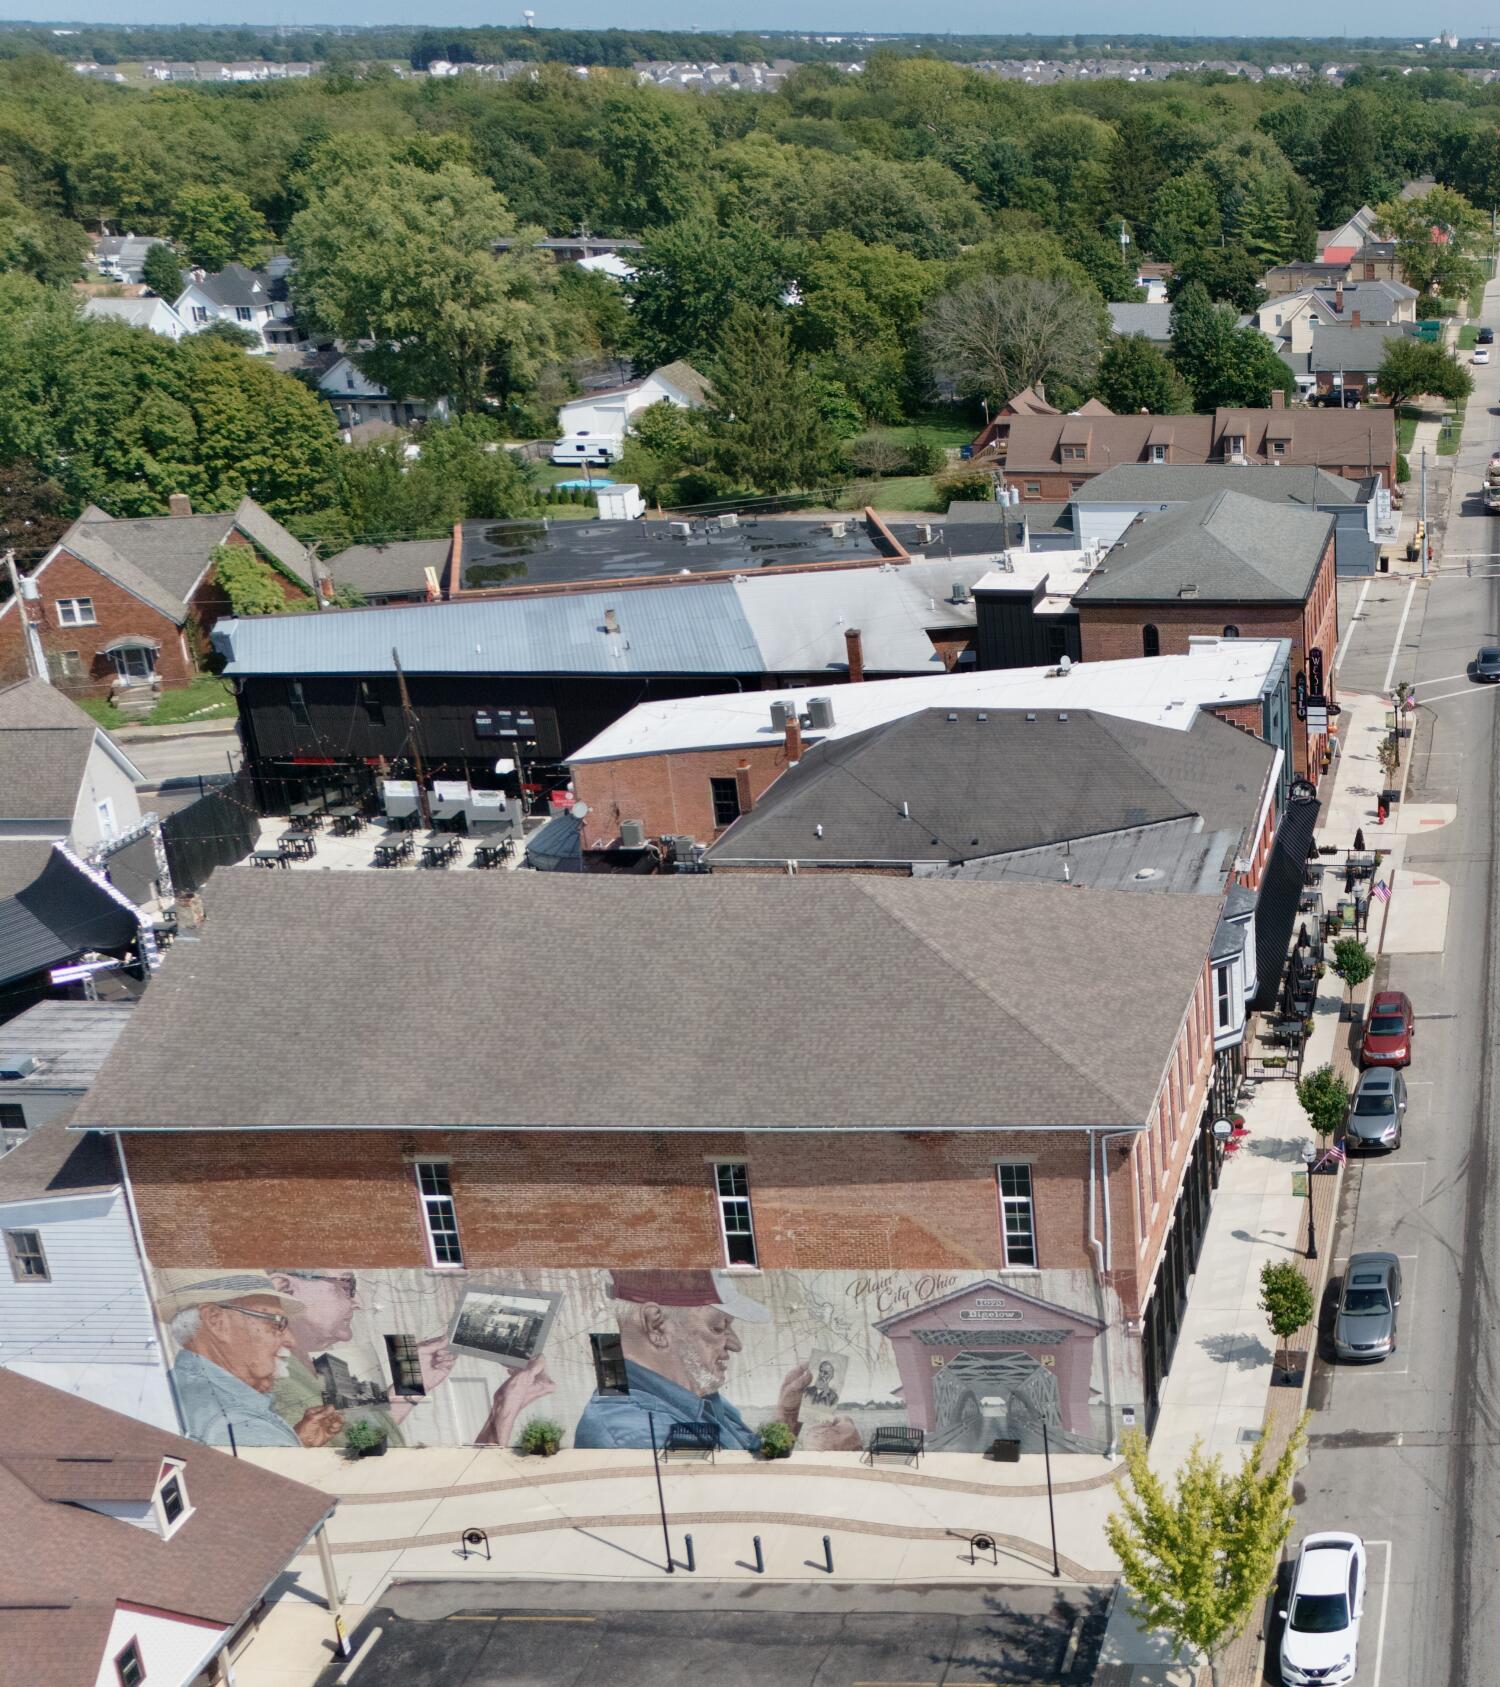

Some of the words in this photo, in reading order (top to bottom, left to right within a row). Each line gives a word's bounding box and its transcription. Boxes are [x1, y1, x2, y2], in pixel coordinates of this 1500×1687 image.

[846, 1275, 892, 1305] Plain
[877, 1286, 910, 1312] City
[915, 1274, 958, 1300] Ohio
[968, 1311, 1015, 1319] Bigelow
